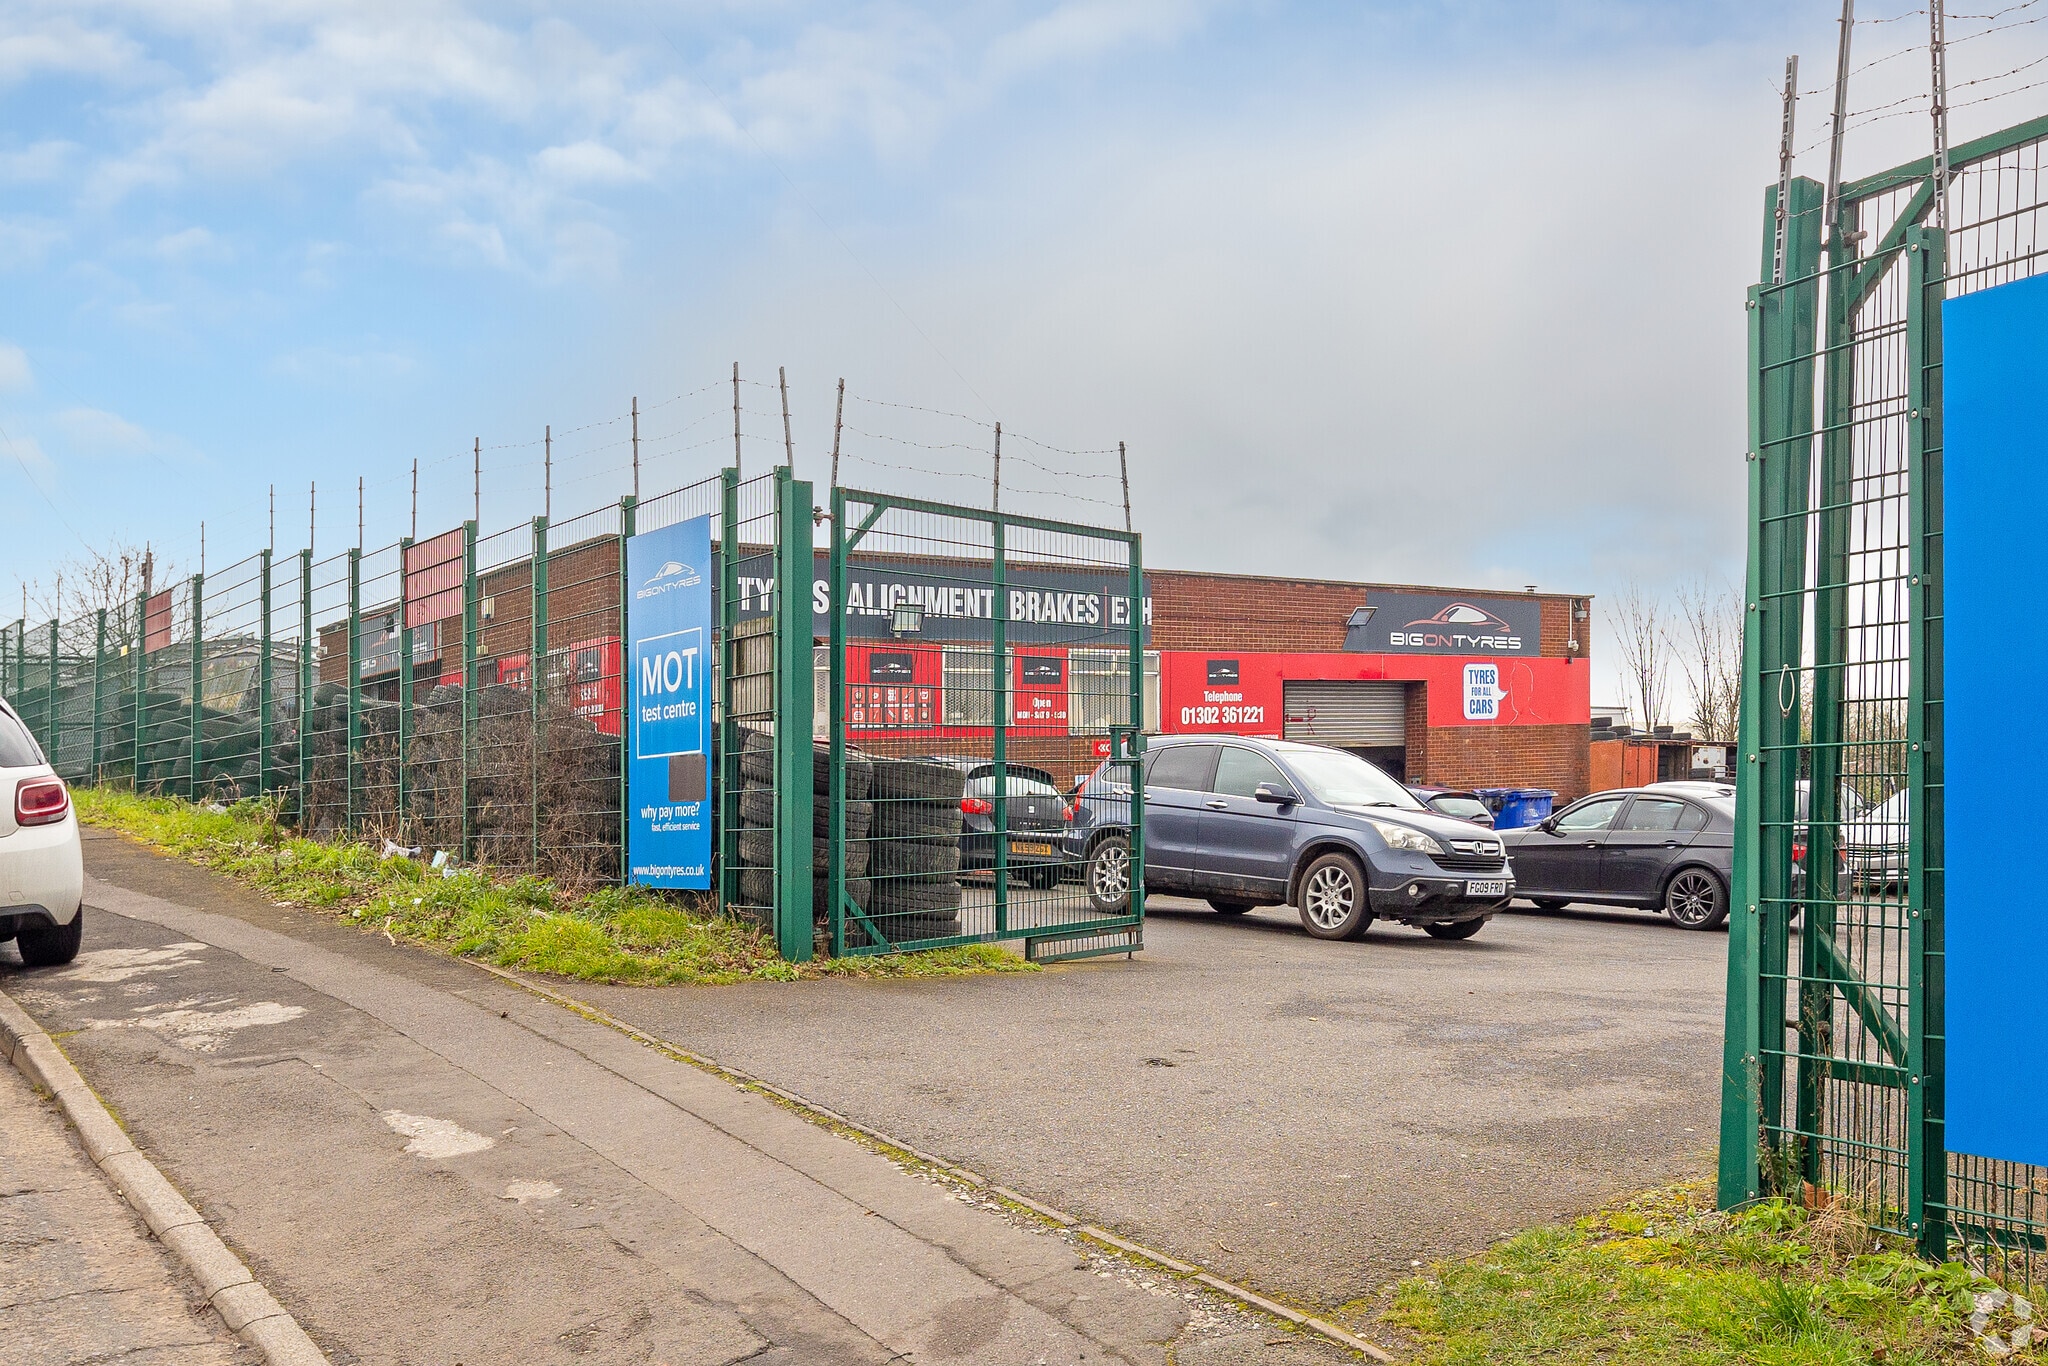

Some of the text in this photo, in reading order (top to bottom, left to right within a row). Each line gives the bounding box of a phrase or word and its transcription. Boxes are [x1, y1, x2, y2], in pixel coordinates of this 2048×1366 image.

[636, 575, 701, 600] BIGONTYRES
[737, 576, 830, 614] TYS
[845, 582, 995, 619] ALIGNMENT
[1009, 590, 1100, 624] BRAKES
[1390, 632, 1522, 650] BIGONTYRES
[642, 647, 698, 697] MOT
[1468, 669, 1496, 685] TYRES
[1203, 690, 1243, 704] Telephone
[1471, 687, 1492, 696] FOR ALL
[1033, 696, 1052, 709] Open
[1469, 700, 1493, 715] CARS
[642, 700, 697, 722] test centre
[1181, 706, 1264, 724] 01302 361221
[640, 801, 700, 821] why pay more?
[662, 821, 682, 832] efficient
[682, 820, 700, 831] service
[632, 863, 705, 879] www.bigontyres.co.uk
[1469, 882, 1489, 893] FG09
